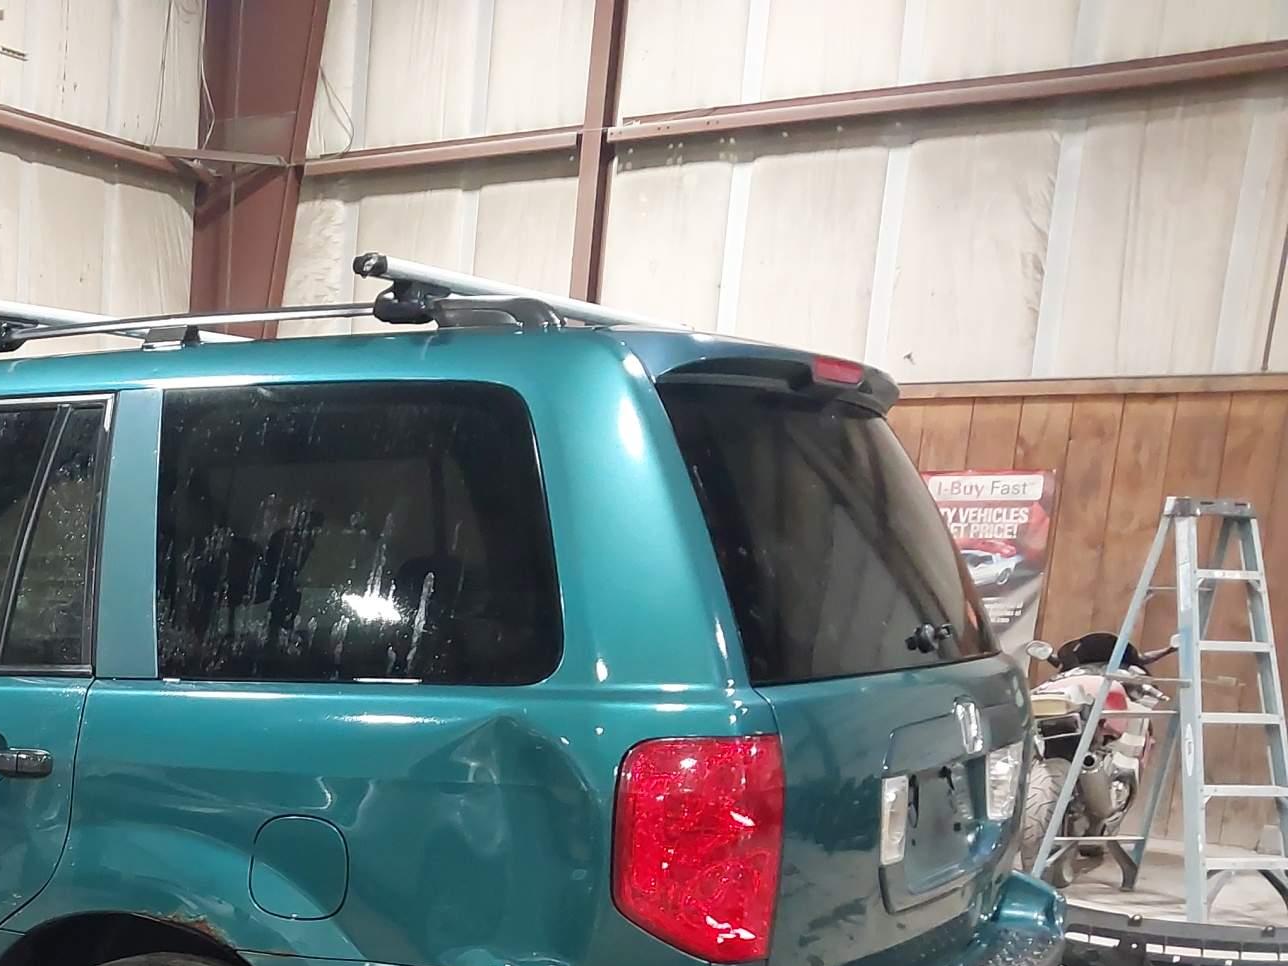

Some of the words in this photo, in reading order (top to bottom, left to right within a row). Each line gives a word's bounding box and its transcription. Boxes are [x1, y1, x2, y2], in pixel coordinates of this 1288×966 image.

[936, 480, 985, 498] I-Buy
[958, 507, 1029, 524] VEHICLES
[969, 523, 1019, 539] PRICE!
